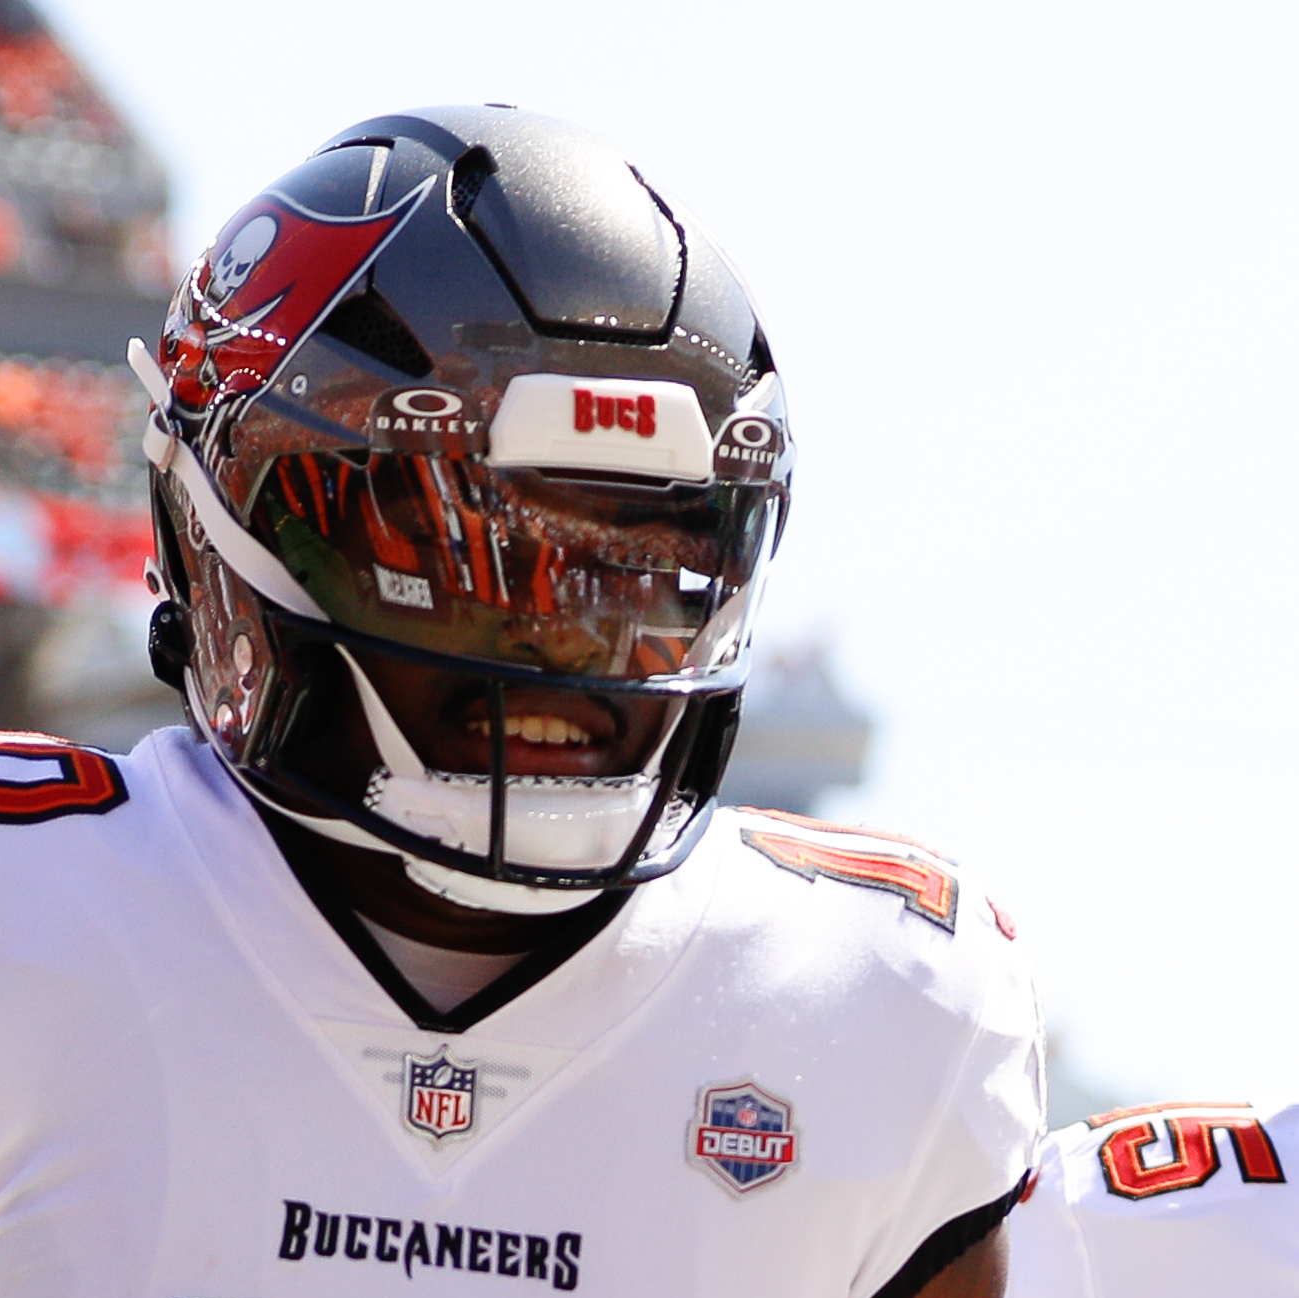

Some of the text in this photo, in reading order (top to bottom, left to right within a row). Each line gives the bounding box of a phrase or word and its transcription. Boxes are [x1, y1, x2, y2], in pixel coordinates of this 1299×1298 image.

[376, 415, 479, 434] OAKLEY
[414, 1088, 470, 1130] NFL
[702, 1130, 791, 1161] DEBUT
[279, 1199, 582, 1291] BUCCANEERS
